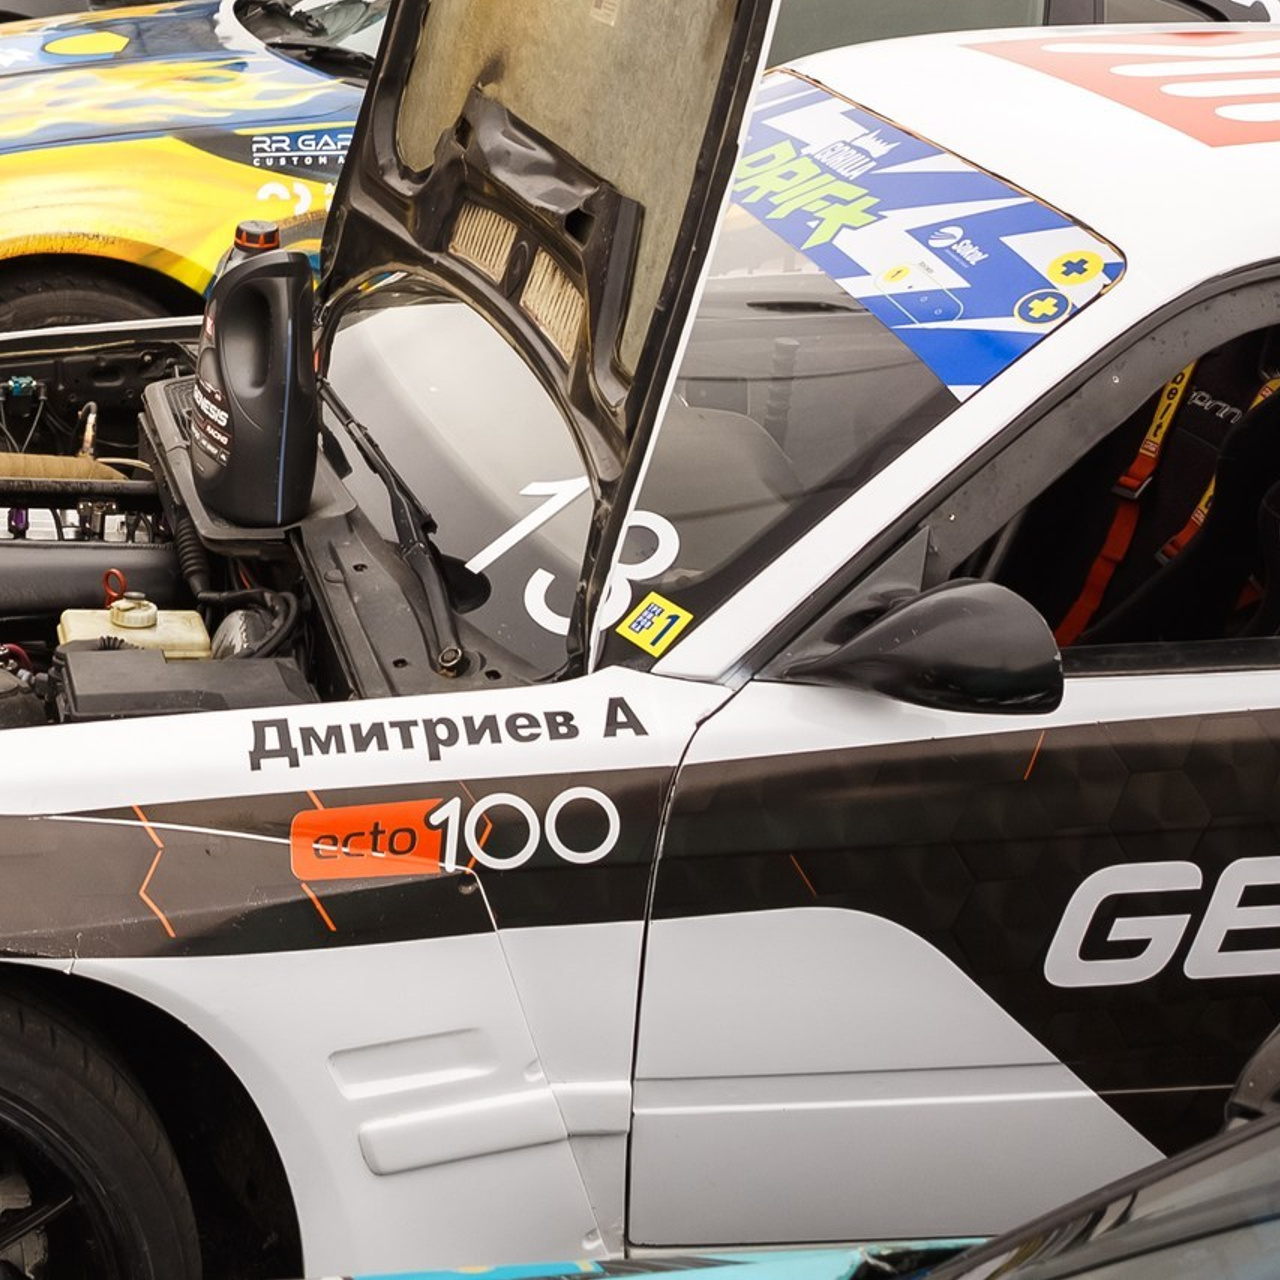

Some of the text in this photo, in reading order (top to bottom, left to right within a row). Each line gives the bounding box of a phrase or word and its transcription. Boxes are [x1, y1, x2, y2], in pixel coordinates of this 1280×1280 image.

[251, 136, 291, 153] RR
[253, 156, 328, 167] CUSTOM
[733, 139, 882, 250] DRIFT
[465, 476, 680, 636] 13
[650, 614, 681, 646] 1
[248, 696, 649, 771] Дмитриев А
